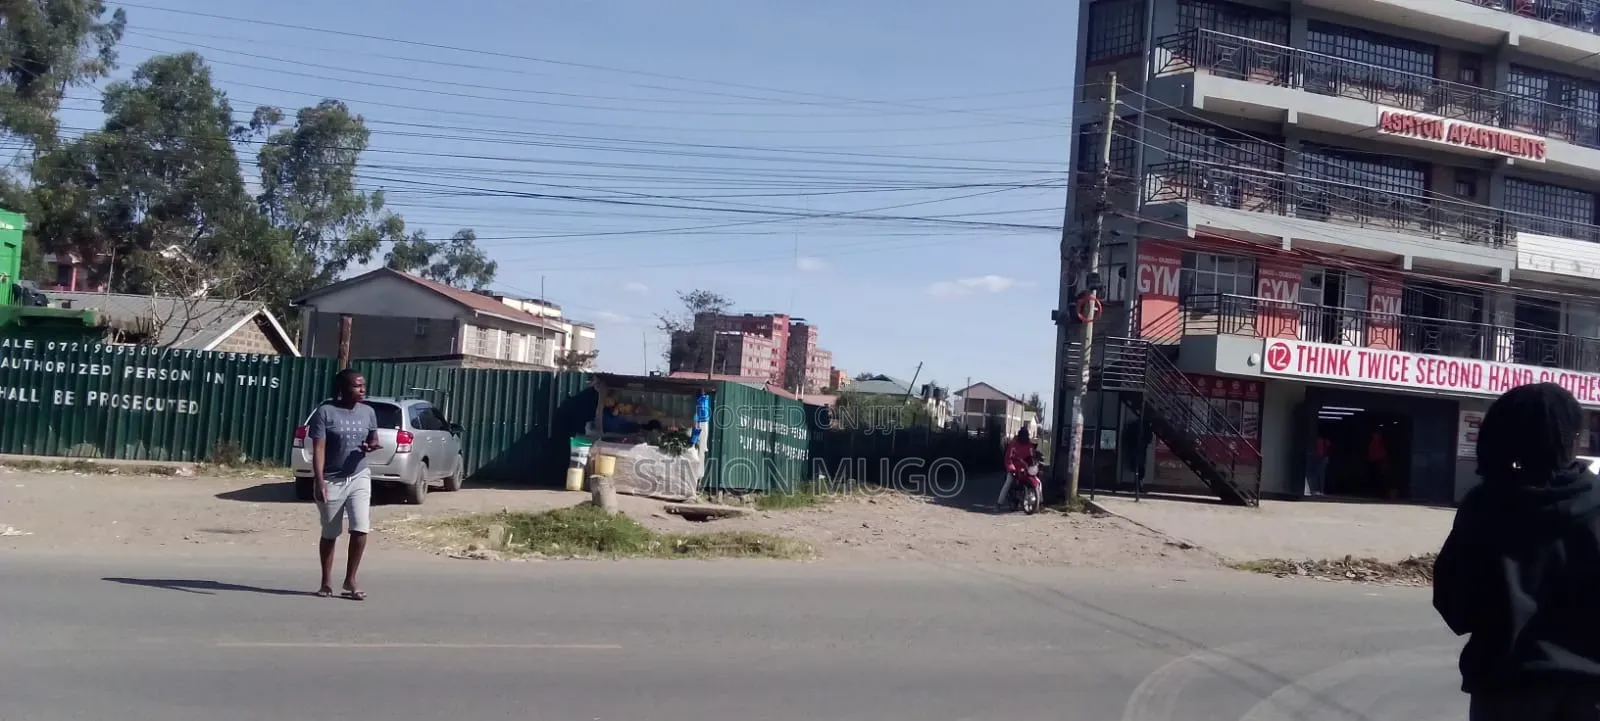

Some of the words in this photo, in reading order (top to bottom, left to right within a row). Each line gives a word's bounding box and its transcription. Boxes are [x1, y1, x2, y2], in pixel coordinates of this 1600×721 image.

[1380, 110, 1445, 141] ASHTON
[1447, 124, 1545, 160] APARTMENTS
[1137, 264, 1181, 297] GYM
[1258, 279, 1300, 310] GYM
[1371, 295, 1402, 323] GYM
[2, 338, 35, 350] ALE
[0, 357, 112, 376] AUTHORIZED
[124, 366, 191, 381] PERSON
[206, 371, 225, 384] IN
[237, 374, 281, 389] THIS
[1296, 344, 1352, 377] THINK
[1358, 351, 1411, 383] TWICE
[1415, 357, 1482, 389] SECOND
[1489, 365, 1534, 392] HAND
[54, 389, 76, 405] BE
[87, 390, 199, 415] PROSECUTED
